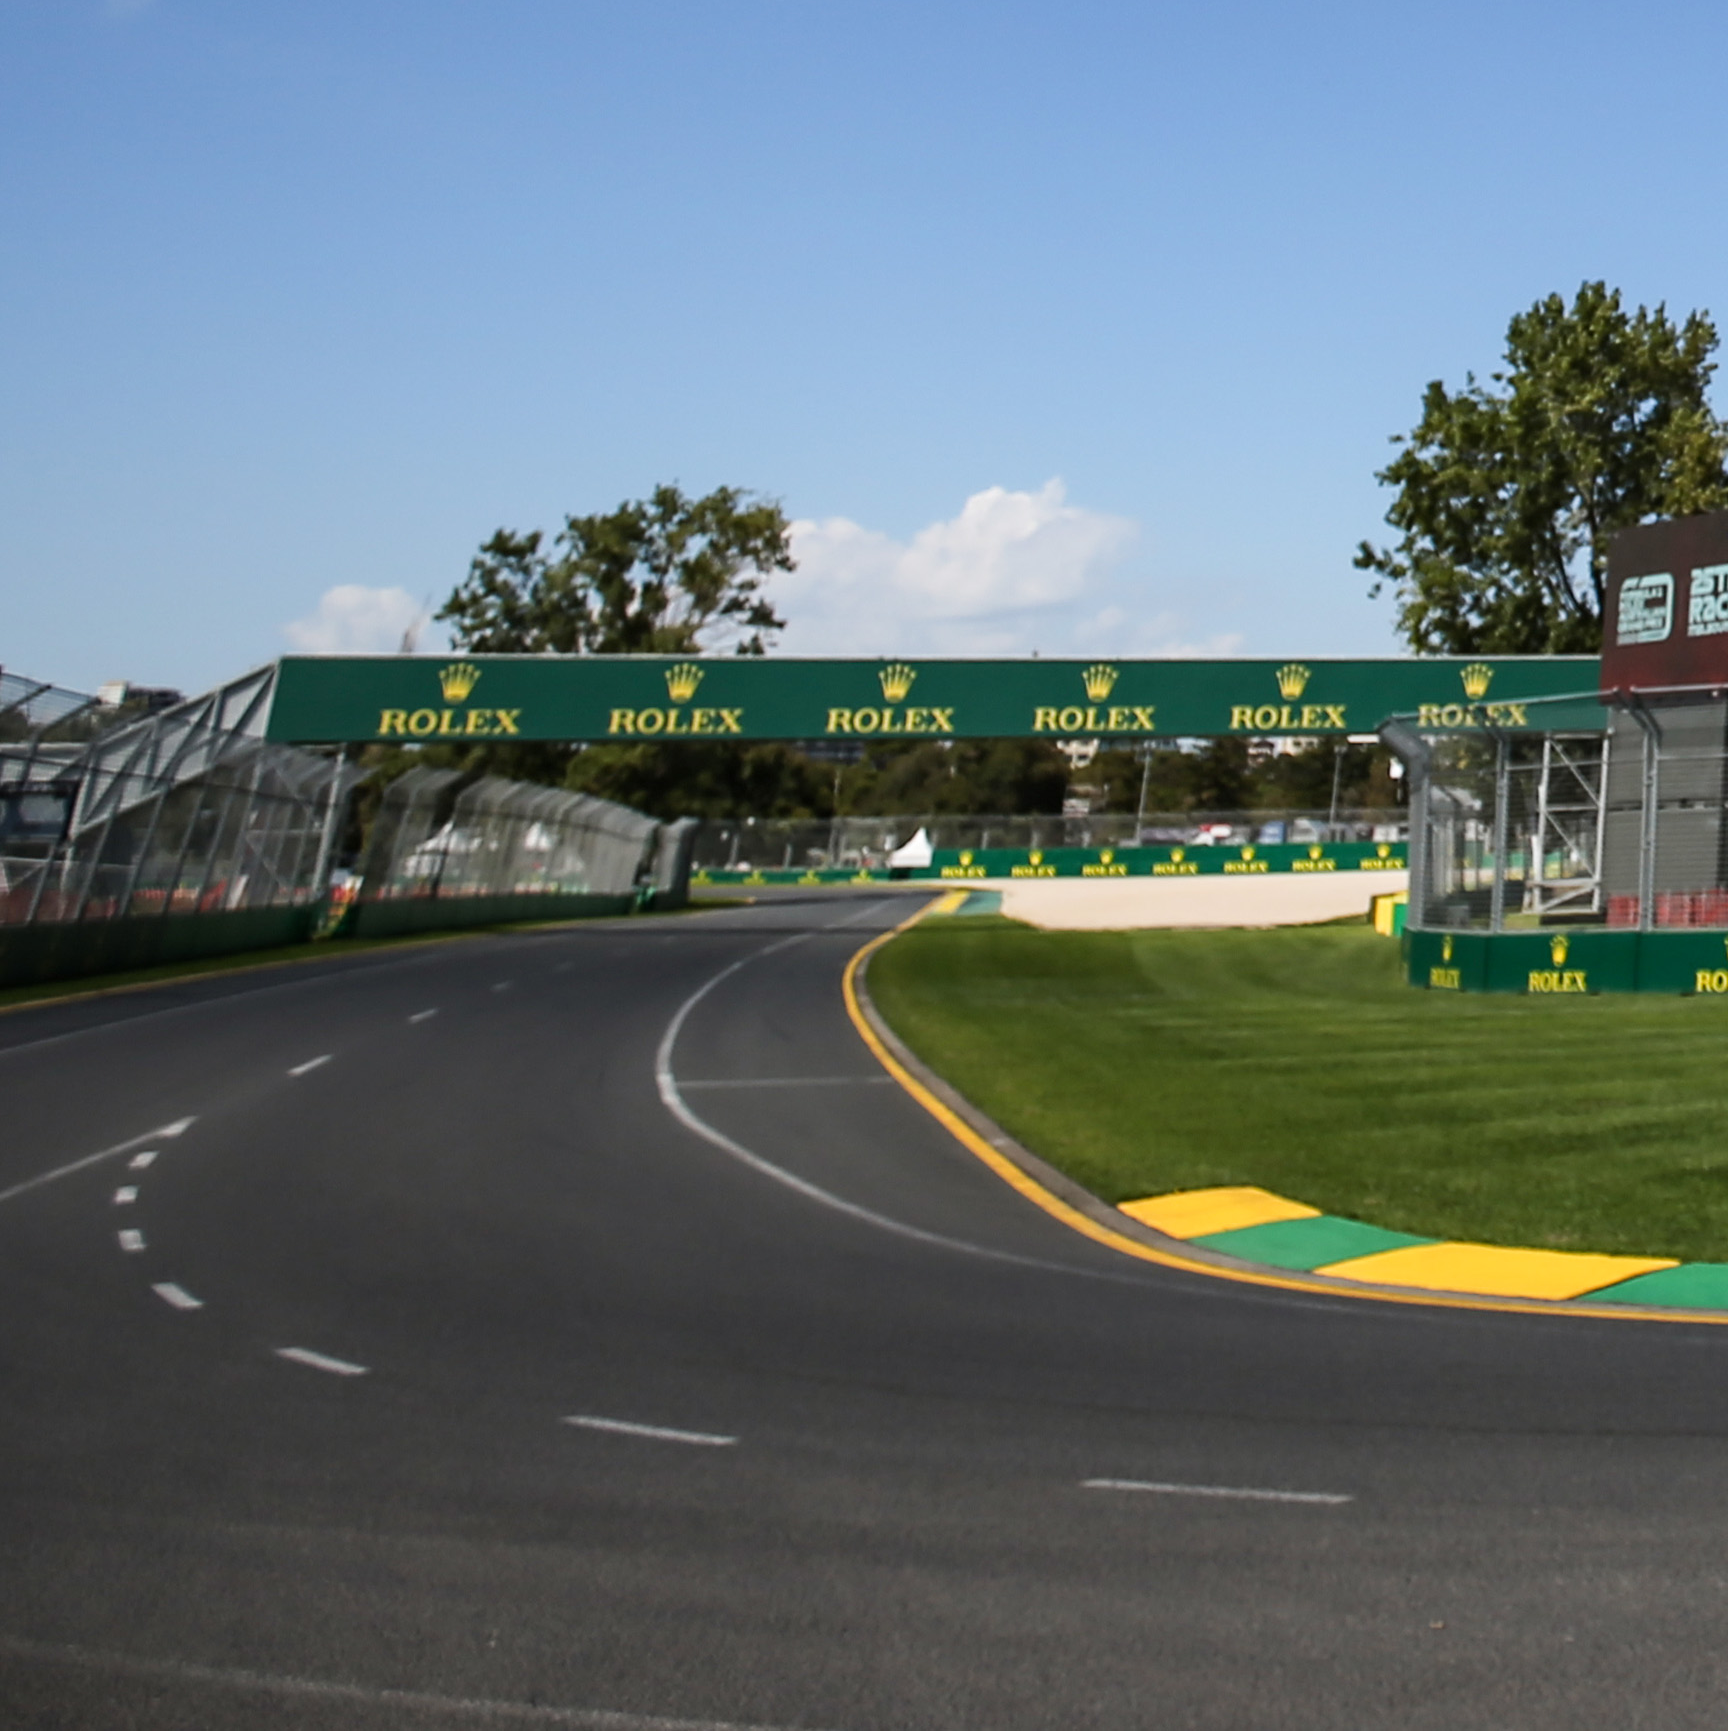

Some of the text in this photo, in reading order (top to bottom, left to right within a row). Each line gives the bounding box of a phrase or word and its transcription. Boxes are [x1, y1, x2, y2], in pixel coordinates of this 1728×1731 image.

[377, 708, 521, 735] ROLEX
[607, 708, 742, 734] ROLEX
[826, 708, 954, 734] ROLEX
[1032, 707, 1154, 731] ROLEX
[1230, 705, 1347, 731] ROLEX
[1528, 970, 1586, 992] ROLEX
